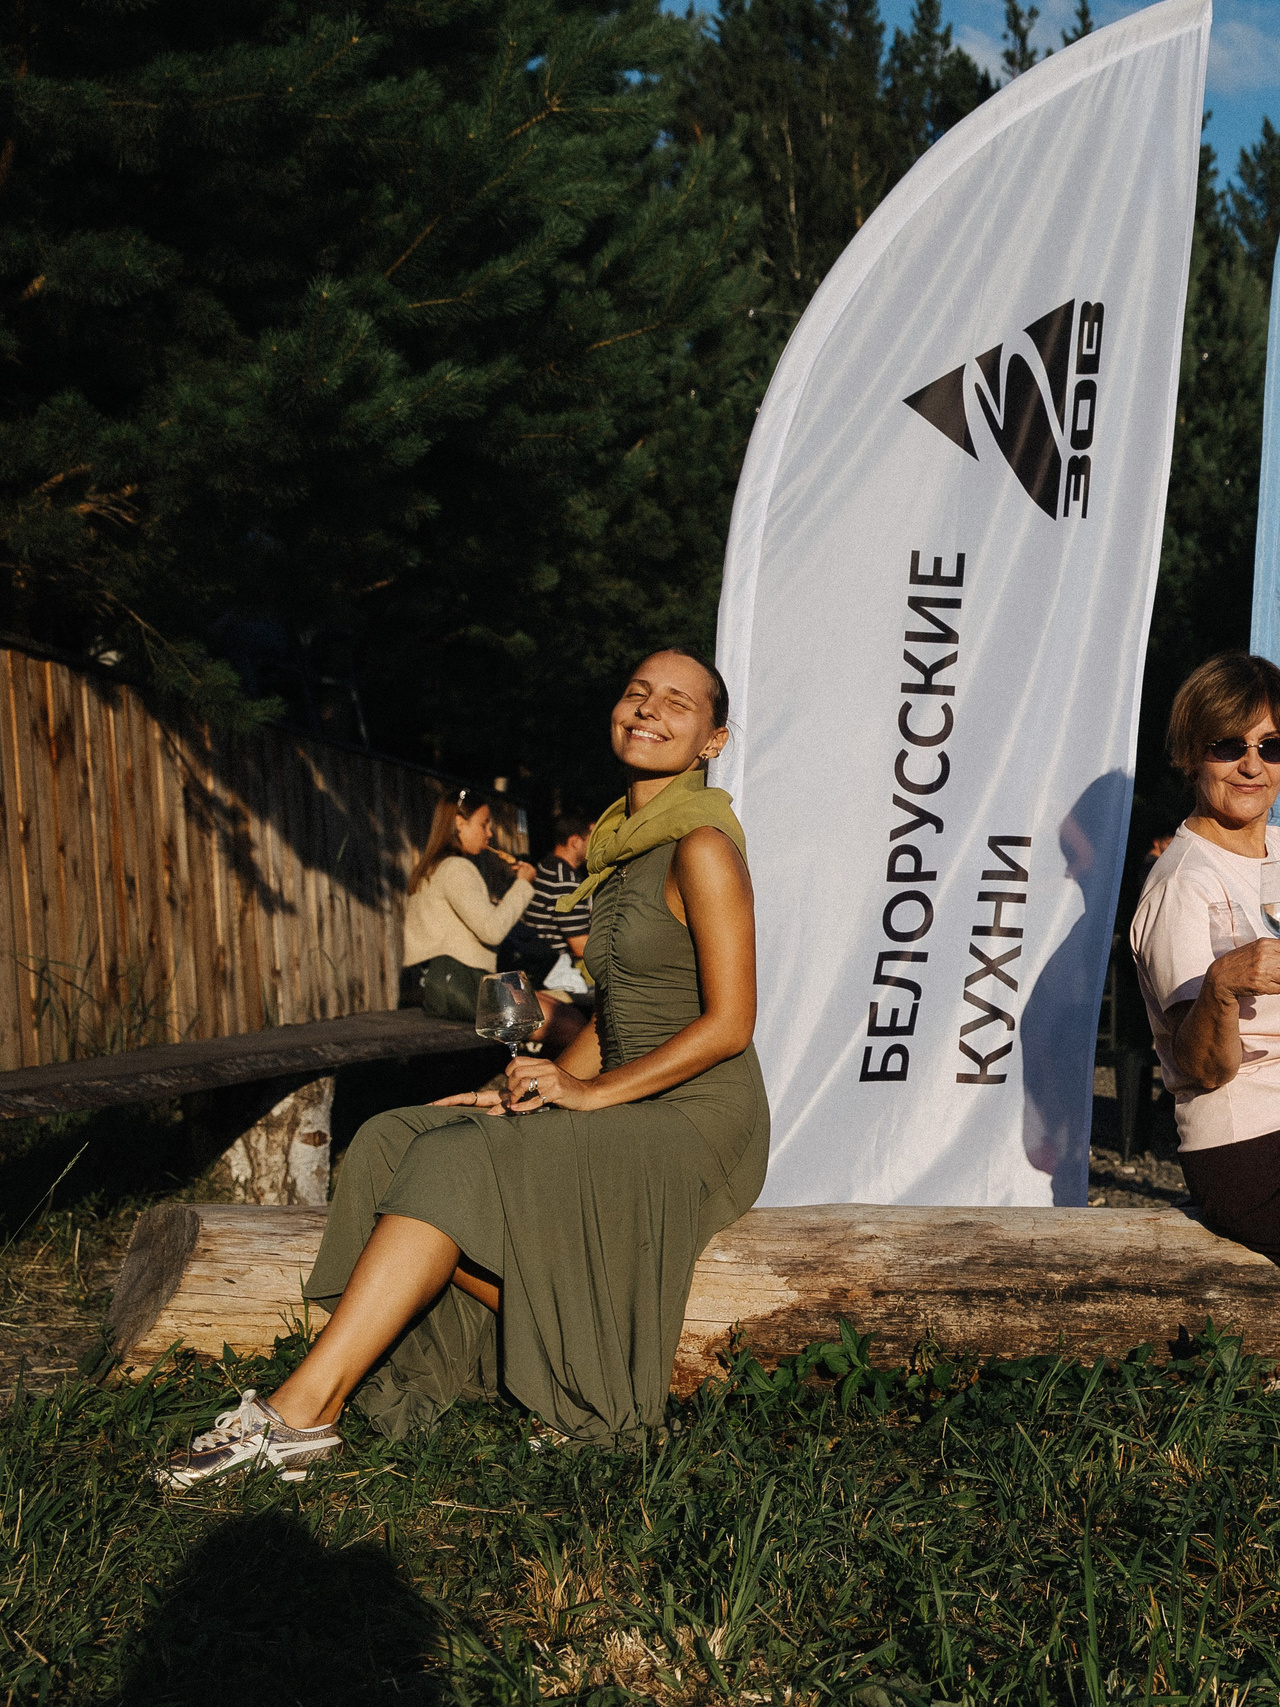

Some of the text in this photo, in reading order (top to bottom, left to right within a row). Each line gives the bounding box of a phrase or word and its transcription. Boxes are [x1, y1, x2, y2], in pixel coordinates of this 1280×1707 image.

[1063, 299, 1106, 520] ЗОВ
[859, 549, 966, 1083] БЕЛОРУССКИЕ
[955, 834, 1032, 1084] КУХНИ
